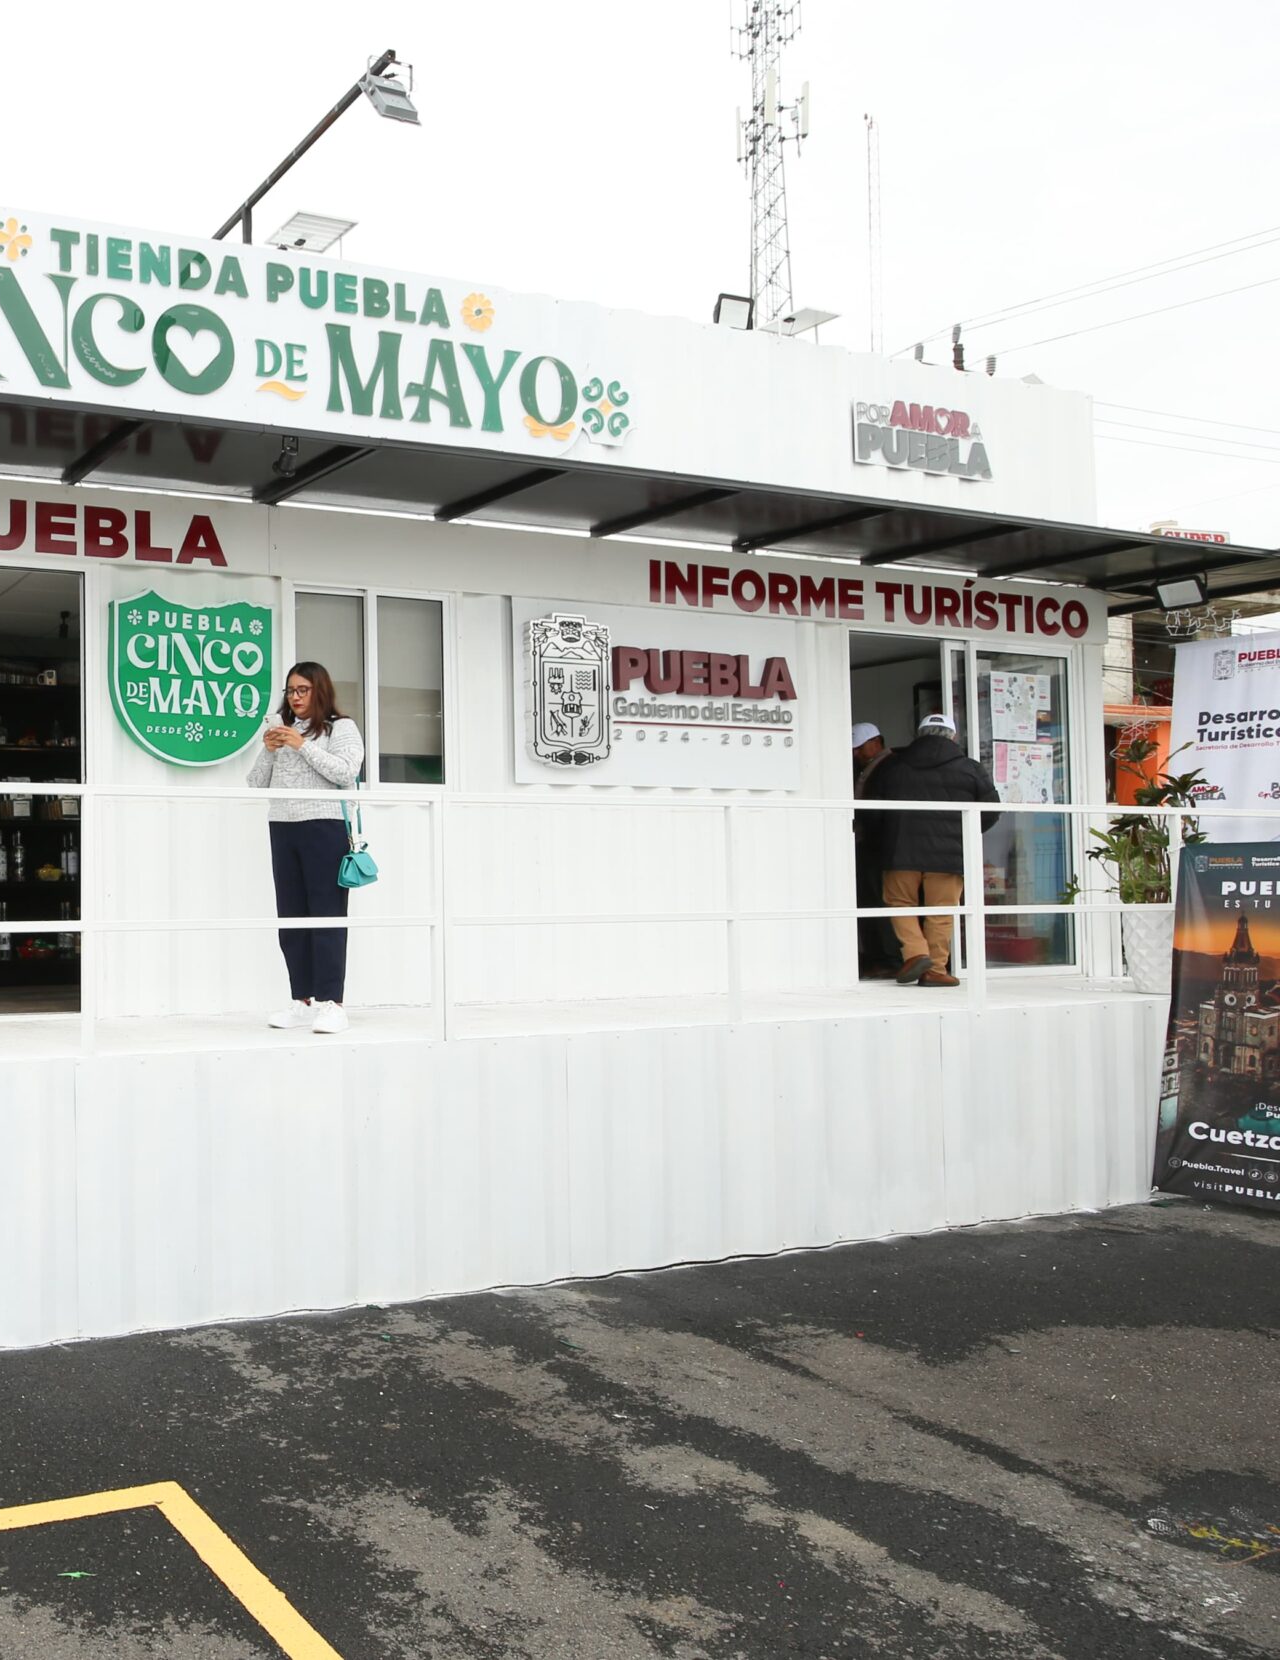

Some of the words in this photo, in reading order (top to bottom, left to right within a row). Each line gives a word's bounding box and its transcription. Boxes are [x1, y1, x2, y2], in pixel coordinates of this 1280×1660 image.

[50, 227, 249, 299] TIENDA
[266, 262, 451, 329] PUEBLA
[254, 338, 308, 382] DE
[325, 322, 579, 434] MAYO
[856, 401, 891, 427] POR
[890, 399, 971, 438] AMOR
[970, 422, 984, 442] A
[857, 422, 993, 480] PUEBLA
[649, 559, 865, 621] INFORME
[875, 578, 1090, 639] TURÍSTICO
[147, 610, 244, 634] PUEBLA
[126, 632, 264, 676] CINCO
[611, 645, 797, 701] PUEBLA
[126, 681, 148, 698] DE
[147, 676, 261, 718] MAYO
[612, 697, 702, 720] Gobierno
[701, 701, 730, 722] del
[731, 703, 793, 725] Estado
[146, 725, 183, 735] DESDE
[208, 728, 238, 738] 1862
[612, 728, 794, 748] 2024-2030
[1224, 899, 1241, 909] ES
[1253, 899, 1271, 909] TU
[1255, 1102, 1280, 1112] ¡Des
